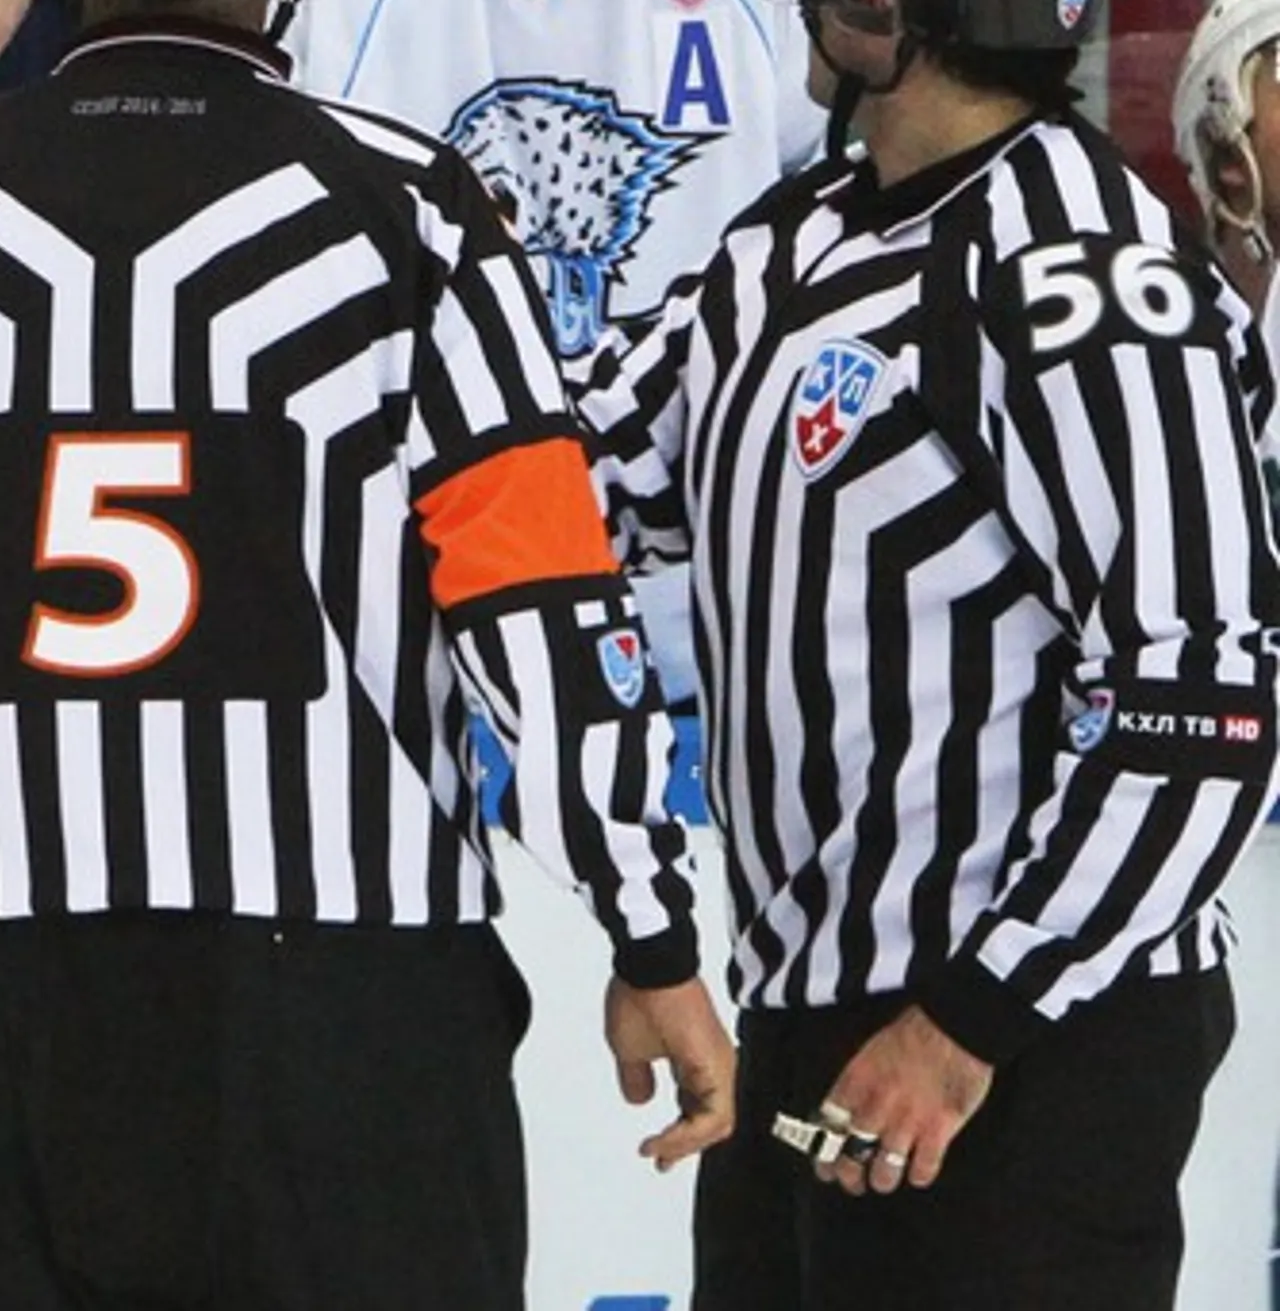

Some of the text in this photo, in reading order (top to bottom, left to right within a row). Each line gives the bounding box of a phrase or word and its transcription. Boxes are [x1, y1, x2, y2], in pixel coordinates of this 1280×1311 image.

[661, 20, 731, 126] A
[1018, 241, 1196, 353] 56
[20, 430, 202, 680] 5
[1116, 711, 1261, 741] КХЛ ТВ HD
